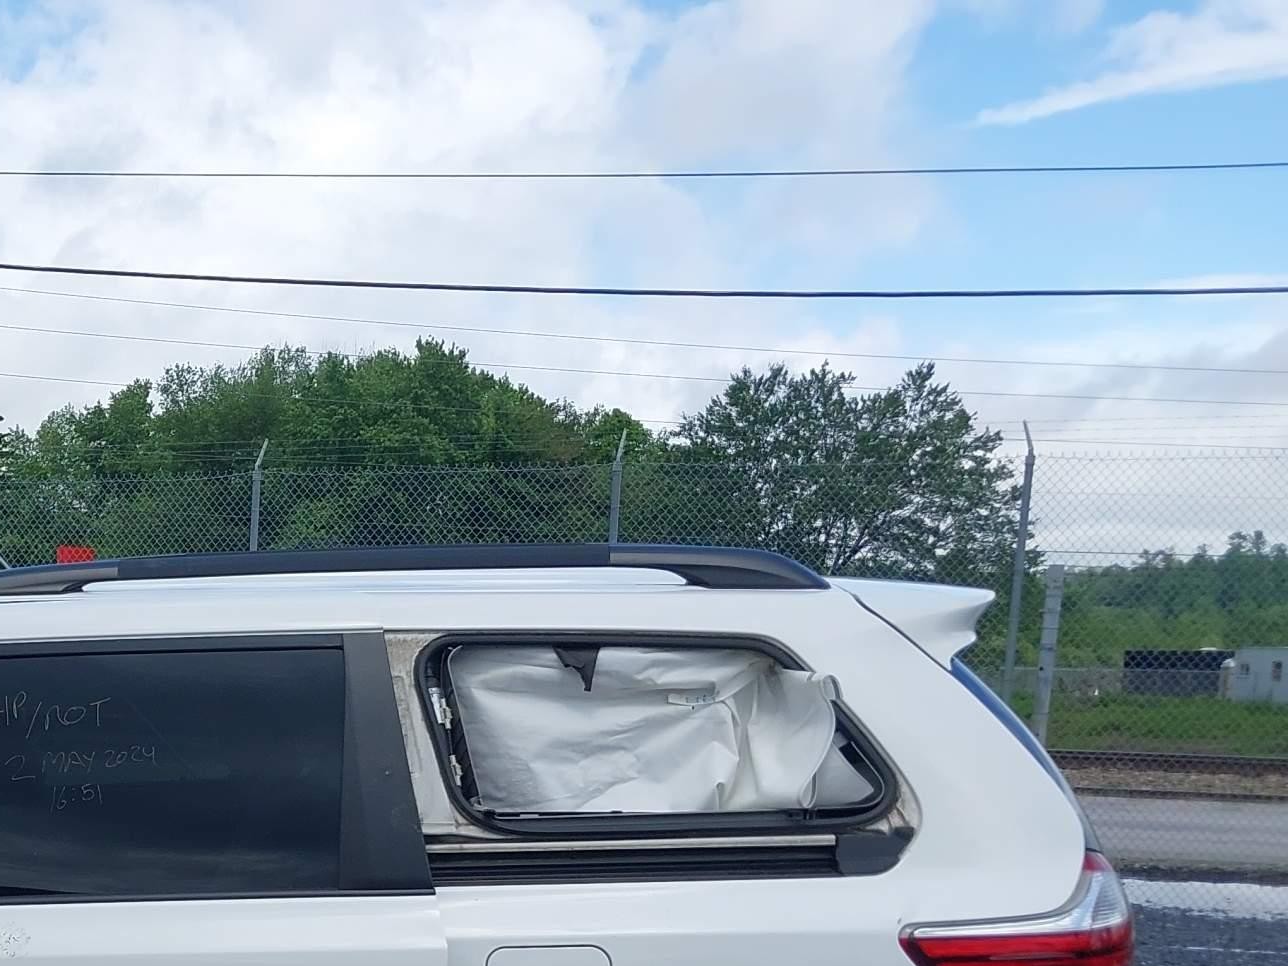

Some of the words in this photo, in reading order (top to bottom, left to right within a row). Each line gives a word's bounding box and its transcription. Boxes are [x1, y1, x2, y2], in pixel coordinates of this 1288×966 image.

[4, 754, 36, 780] 2
[41, 751, 96, 774] MAY
[103, 744, 161, 769] 2024
[49, 782, 103, 813] 16:51
